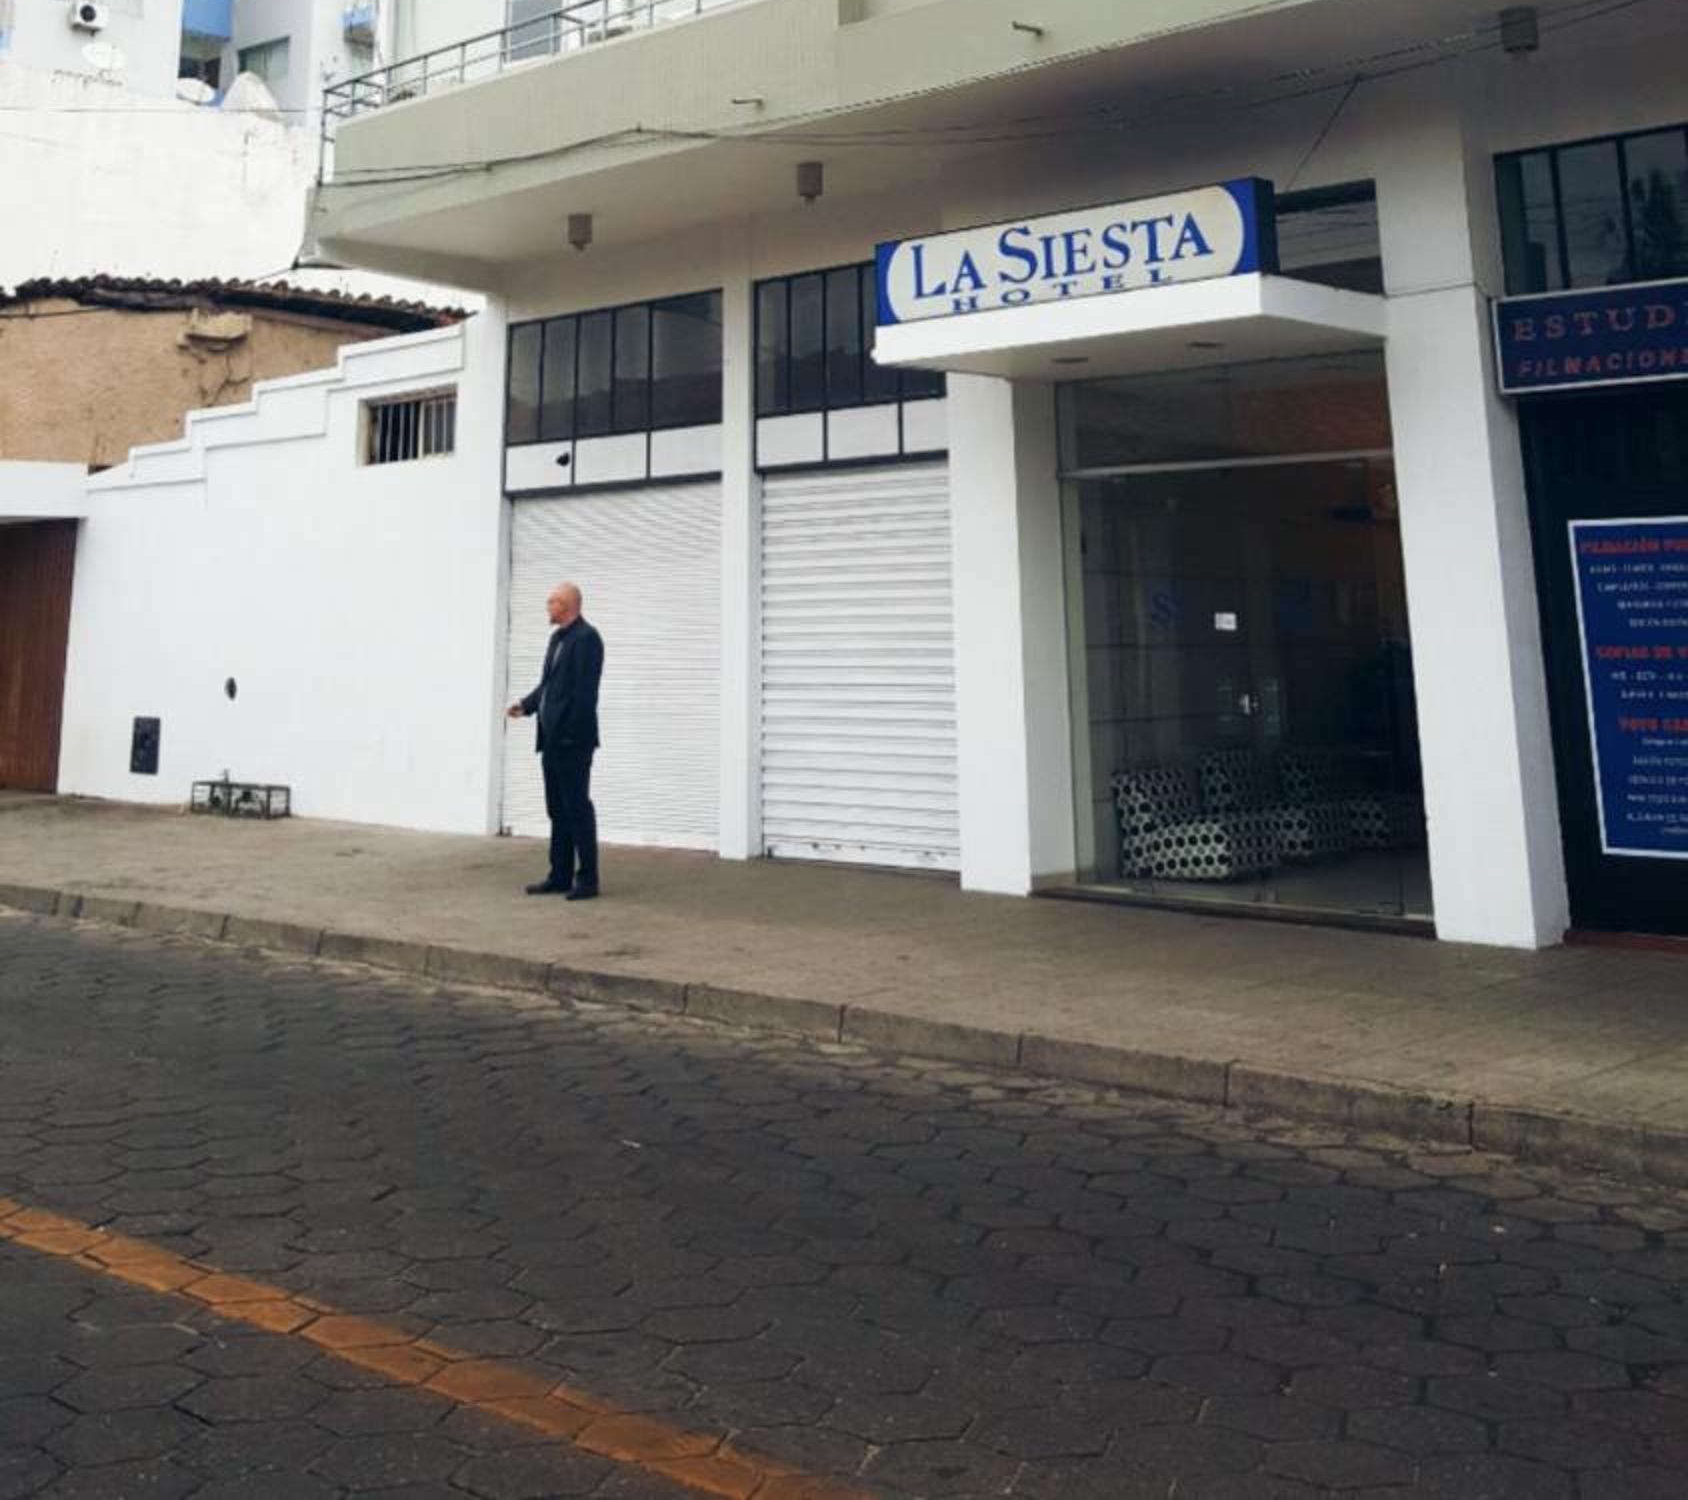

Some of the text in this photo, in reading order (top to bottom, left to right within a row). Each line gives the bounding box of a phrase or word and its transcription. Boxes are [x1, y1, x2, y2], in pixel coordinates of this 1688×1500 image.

[911, 211, 1214, 300] LA SIESTA
[952, 268, 1173, 313] HOTEL
